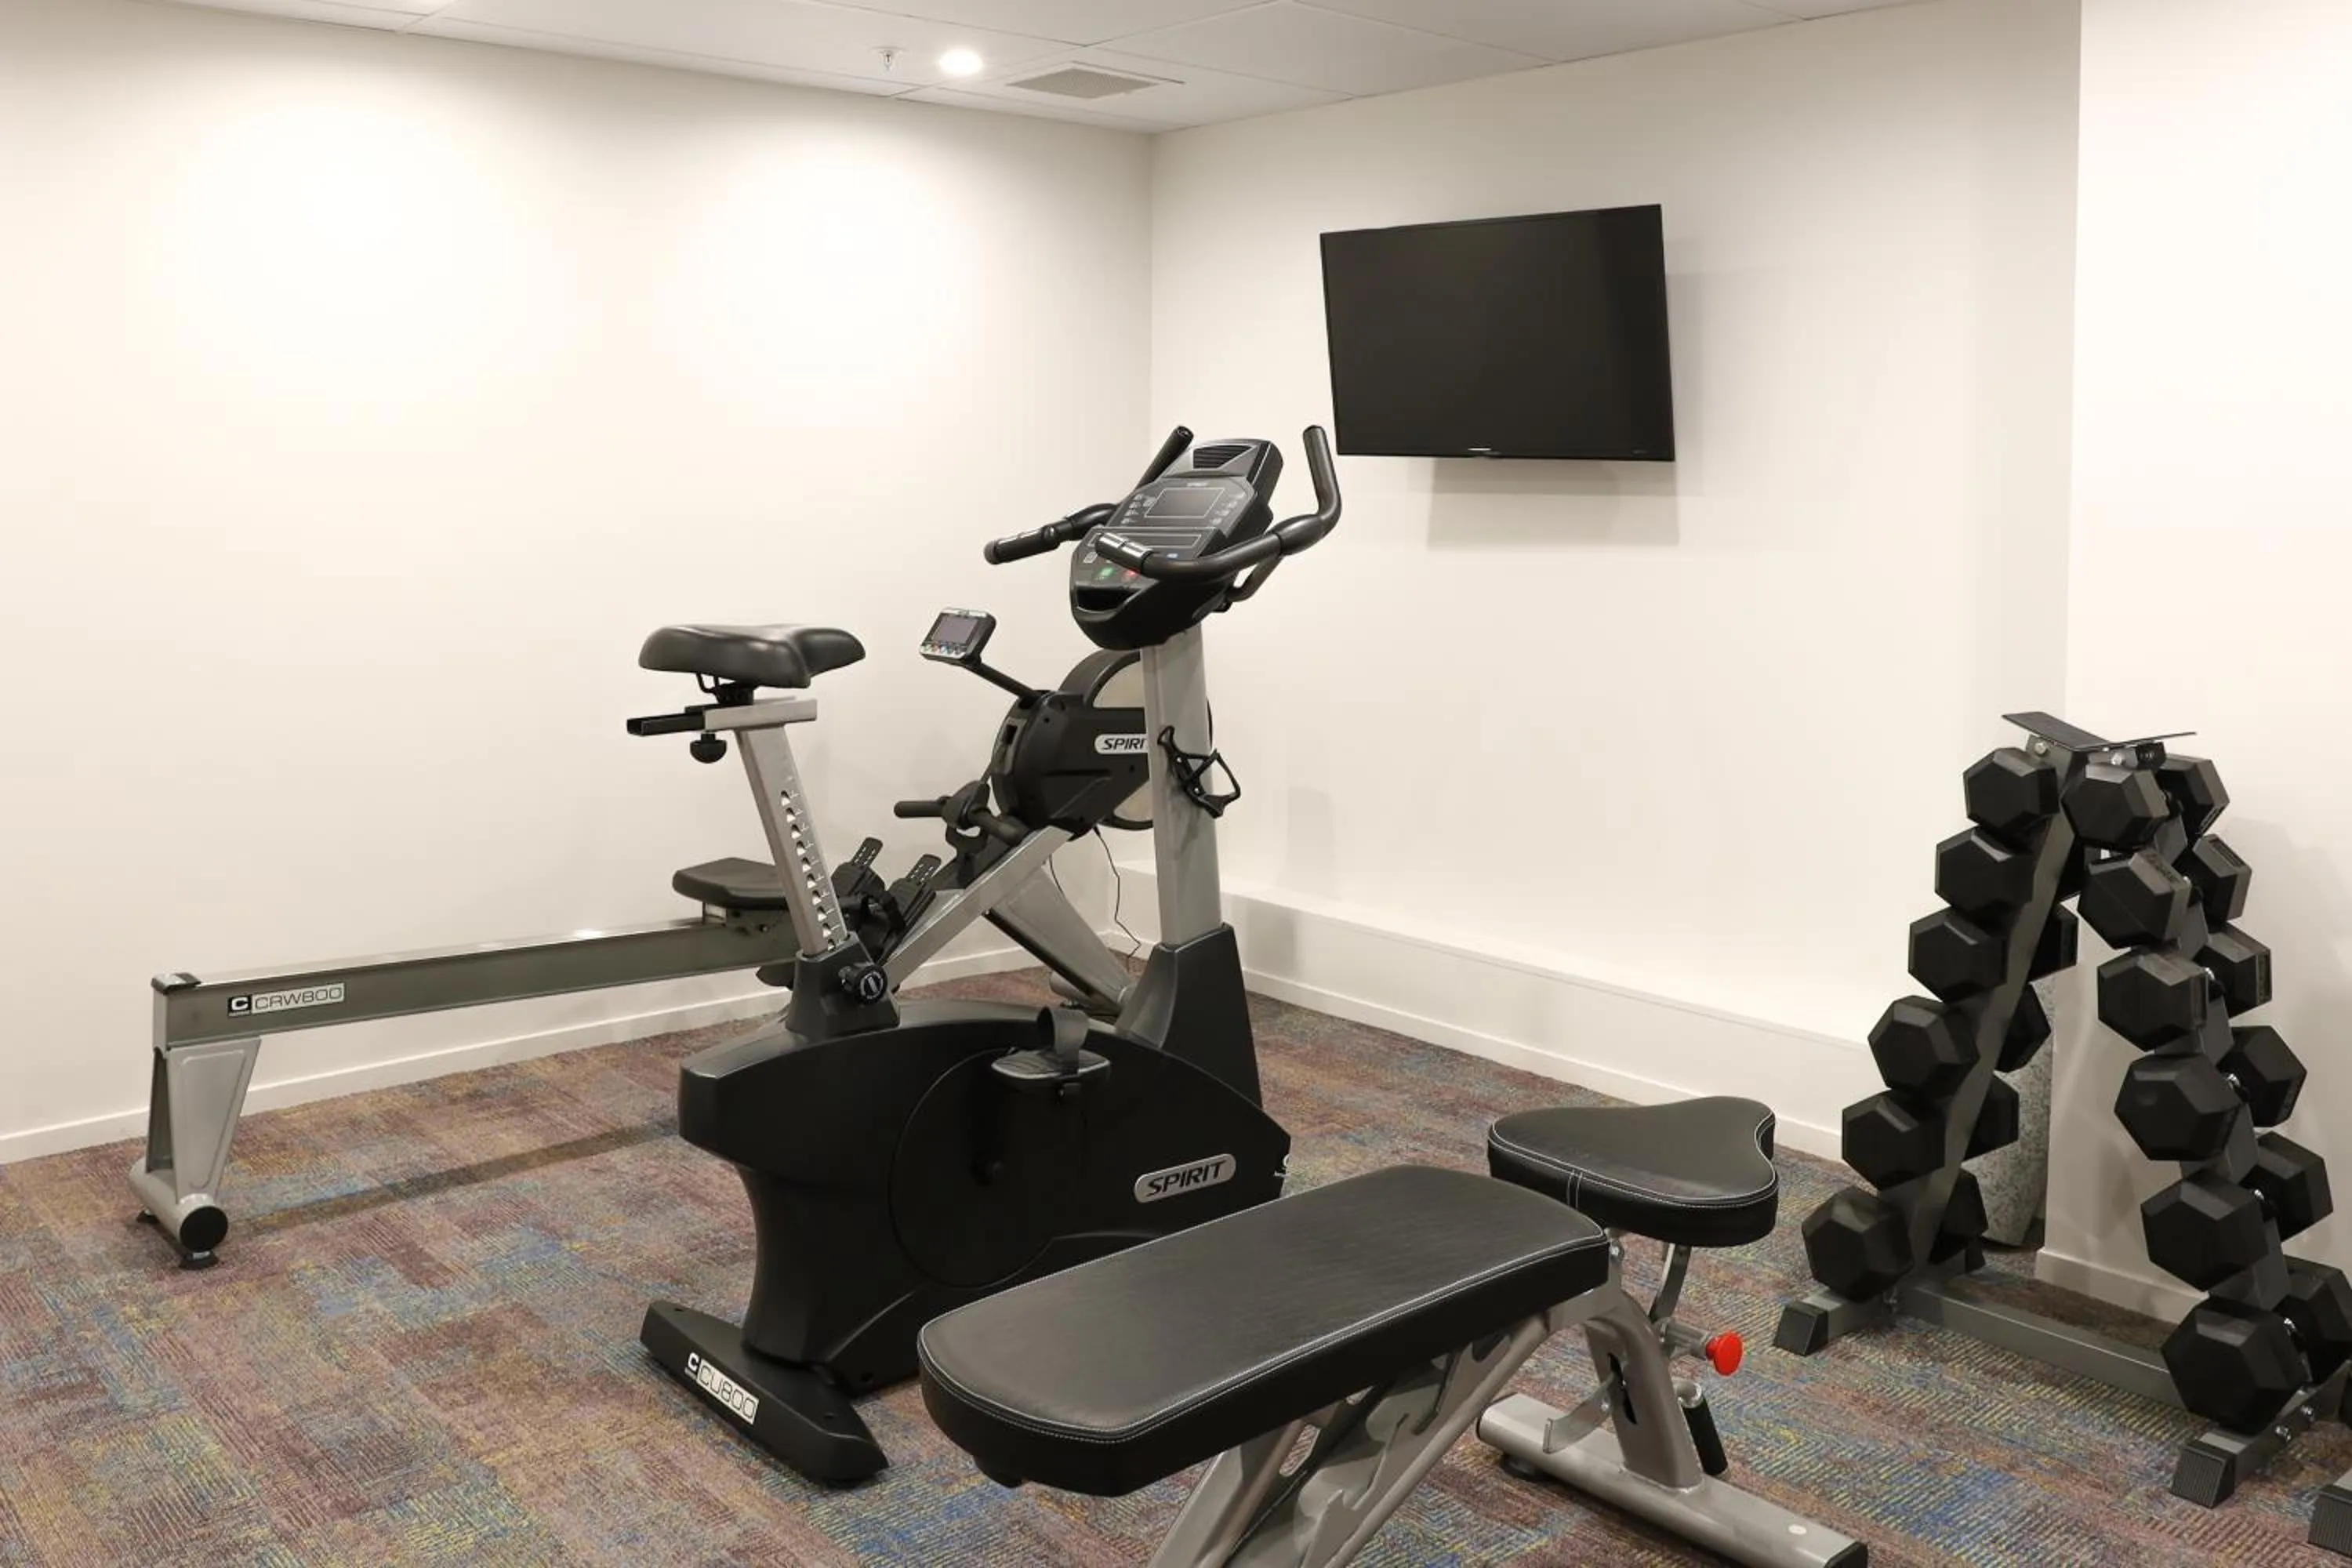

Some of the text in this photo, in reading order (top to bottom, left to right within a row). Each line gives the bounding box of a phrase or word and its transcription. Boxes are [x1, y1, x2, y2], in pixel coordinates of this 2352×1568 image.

[1102, 738, 1147, 750] SPIRI
[255, 986, 343, 1010] CRW800
[1146, 1160, 1227, 1197] SPIRIT
[699, 1364, 757, 1419] CU800
